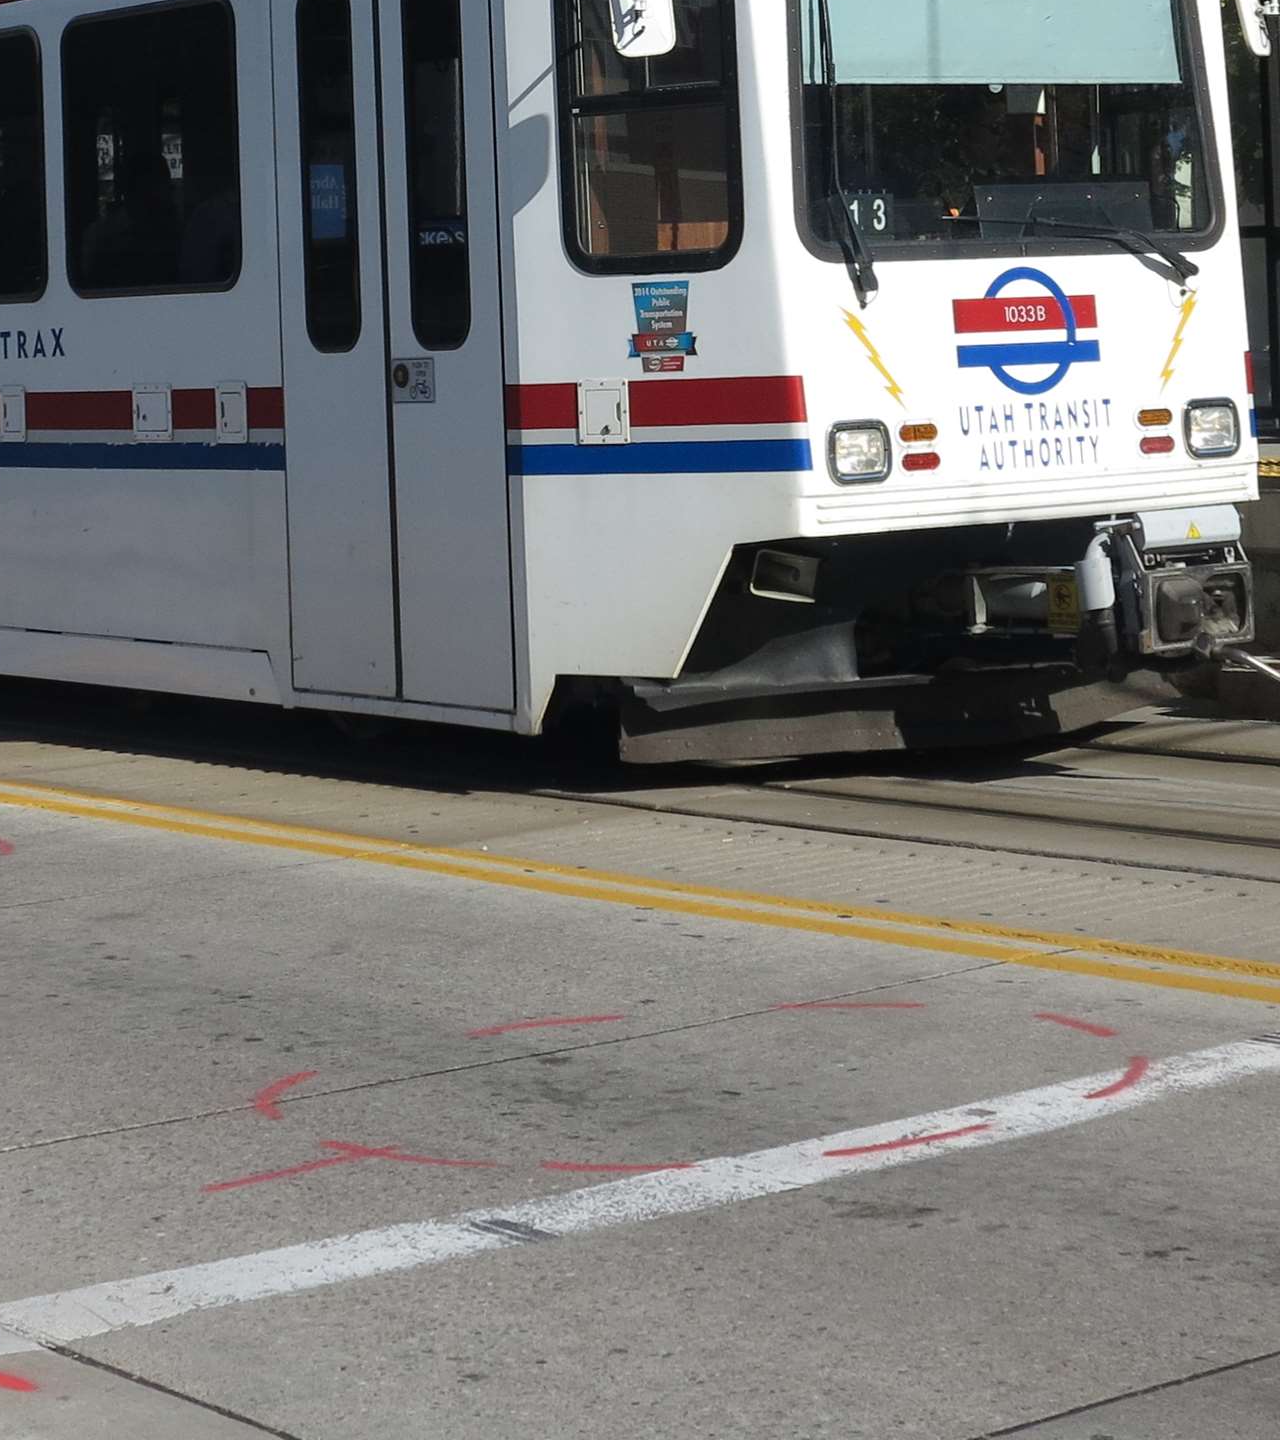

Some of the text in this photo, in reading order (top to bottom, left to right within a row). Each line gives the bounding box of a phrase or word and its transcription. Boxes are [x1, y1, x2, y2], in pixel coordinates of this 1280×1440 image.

[1004, 304, 1047, 323] 1033B
[0, 327, 65, 359] TRAX
[958, 398, 1111, 436] UTAH TRANSIT
[979, 435, 1100, 471] AUTHORITY
